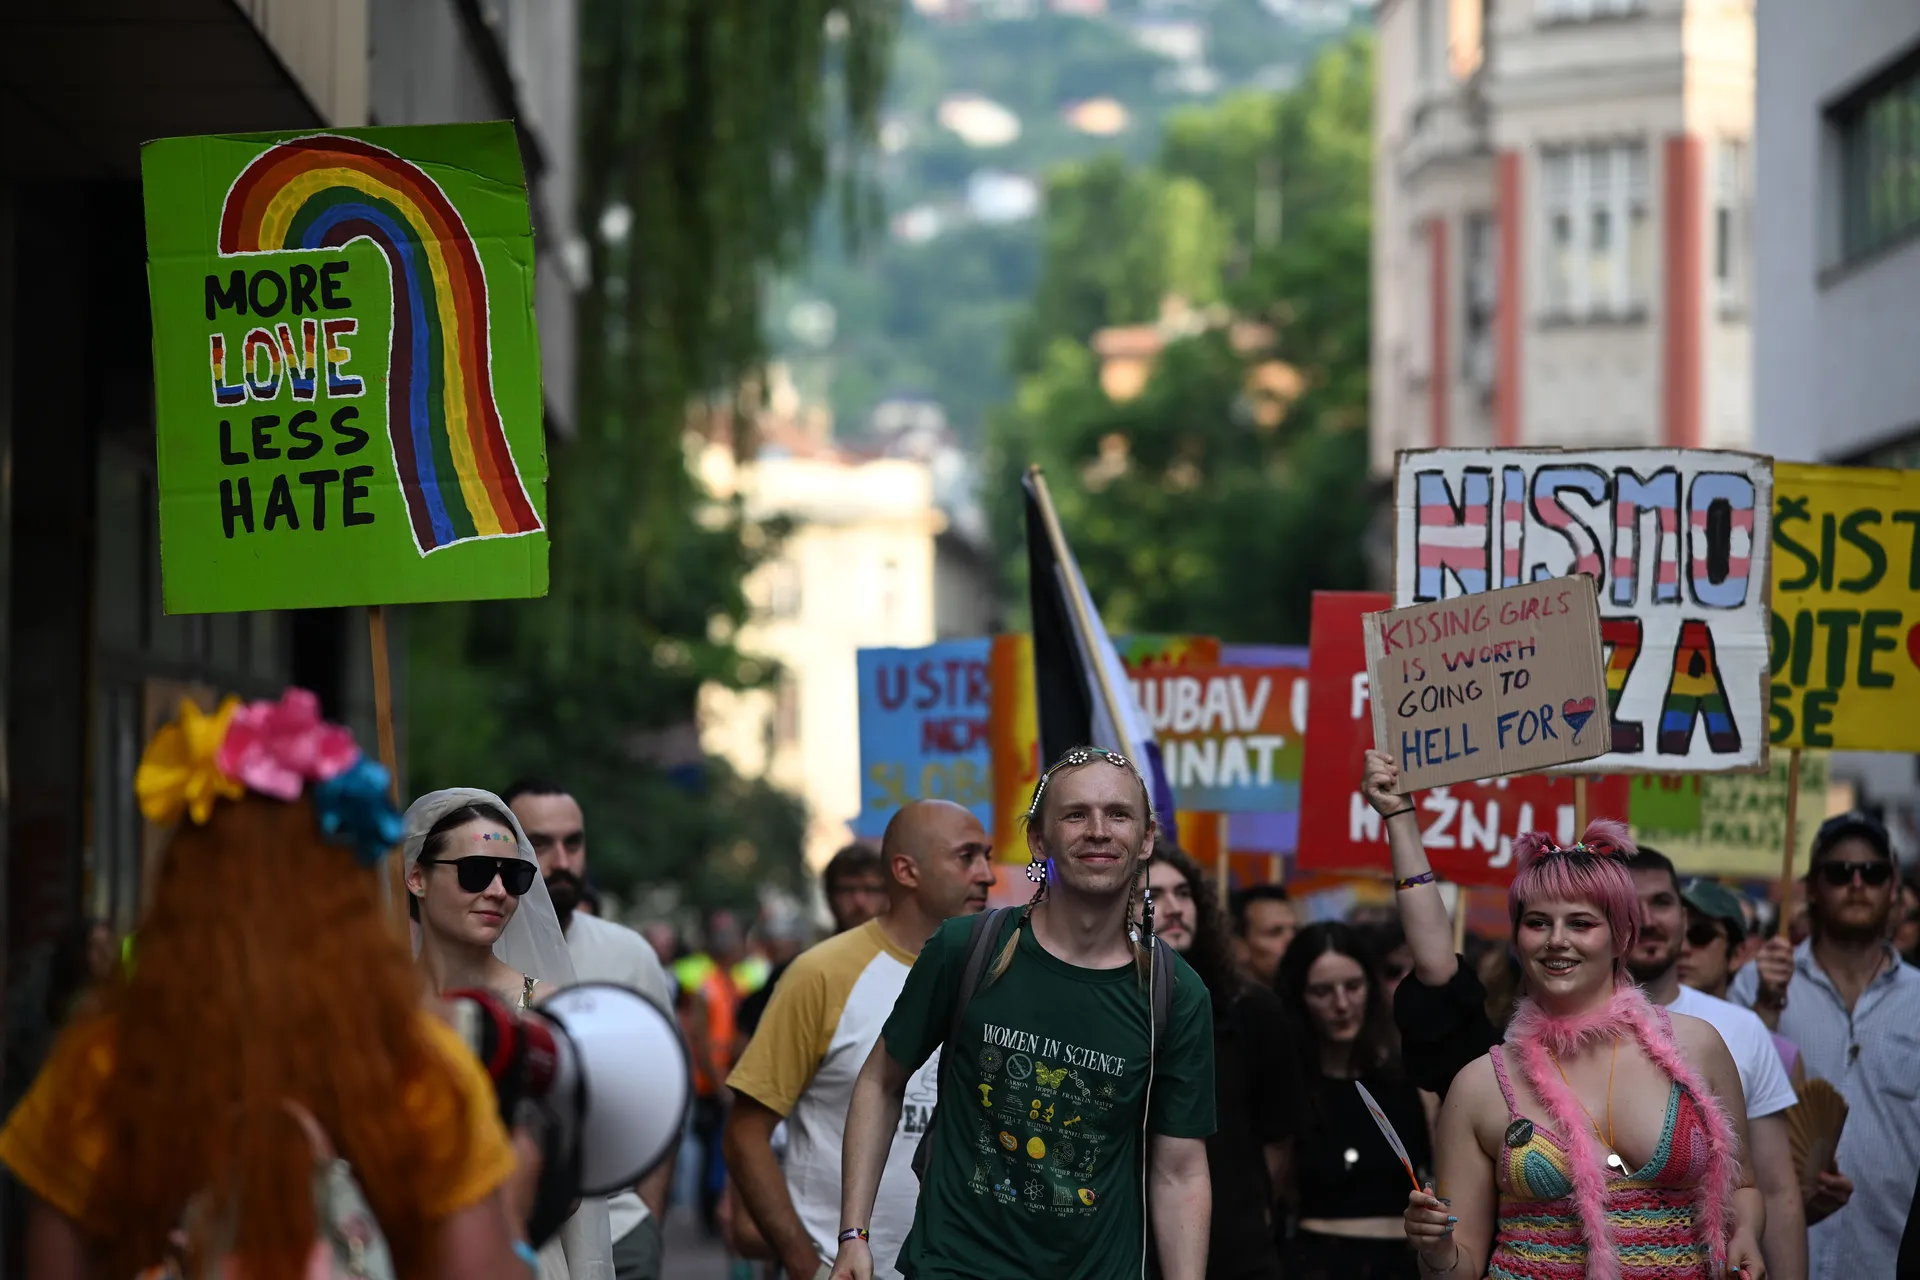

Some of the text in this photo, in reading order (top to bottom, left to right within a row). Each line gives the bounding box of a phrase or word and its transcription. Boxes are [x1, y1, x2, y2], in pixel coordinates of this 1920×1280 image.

[205, 261, 352, 321] MORE
[209, 318, 366, 407] LOVE
[219, 406, 370, 466] LESS
[219, 465, 375, 539] HATE
[1413, 463, 1756, 609] NISMO
[1381, 591, 1572, 656] KISSING GIRLS
[1403, 636, 1536, 683] IS WORTH
[1398, 680, 1483, 718] GOING
[1500, 669, 1530, 695] TO
[1402, 704, 1559, 772] HELL FOR
[982, 1022, 1126, 1077] WOMEN IN SCIENCE
